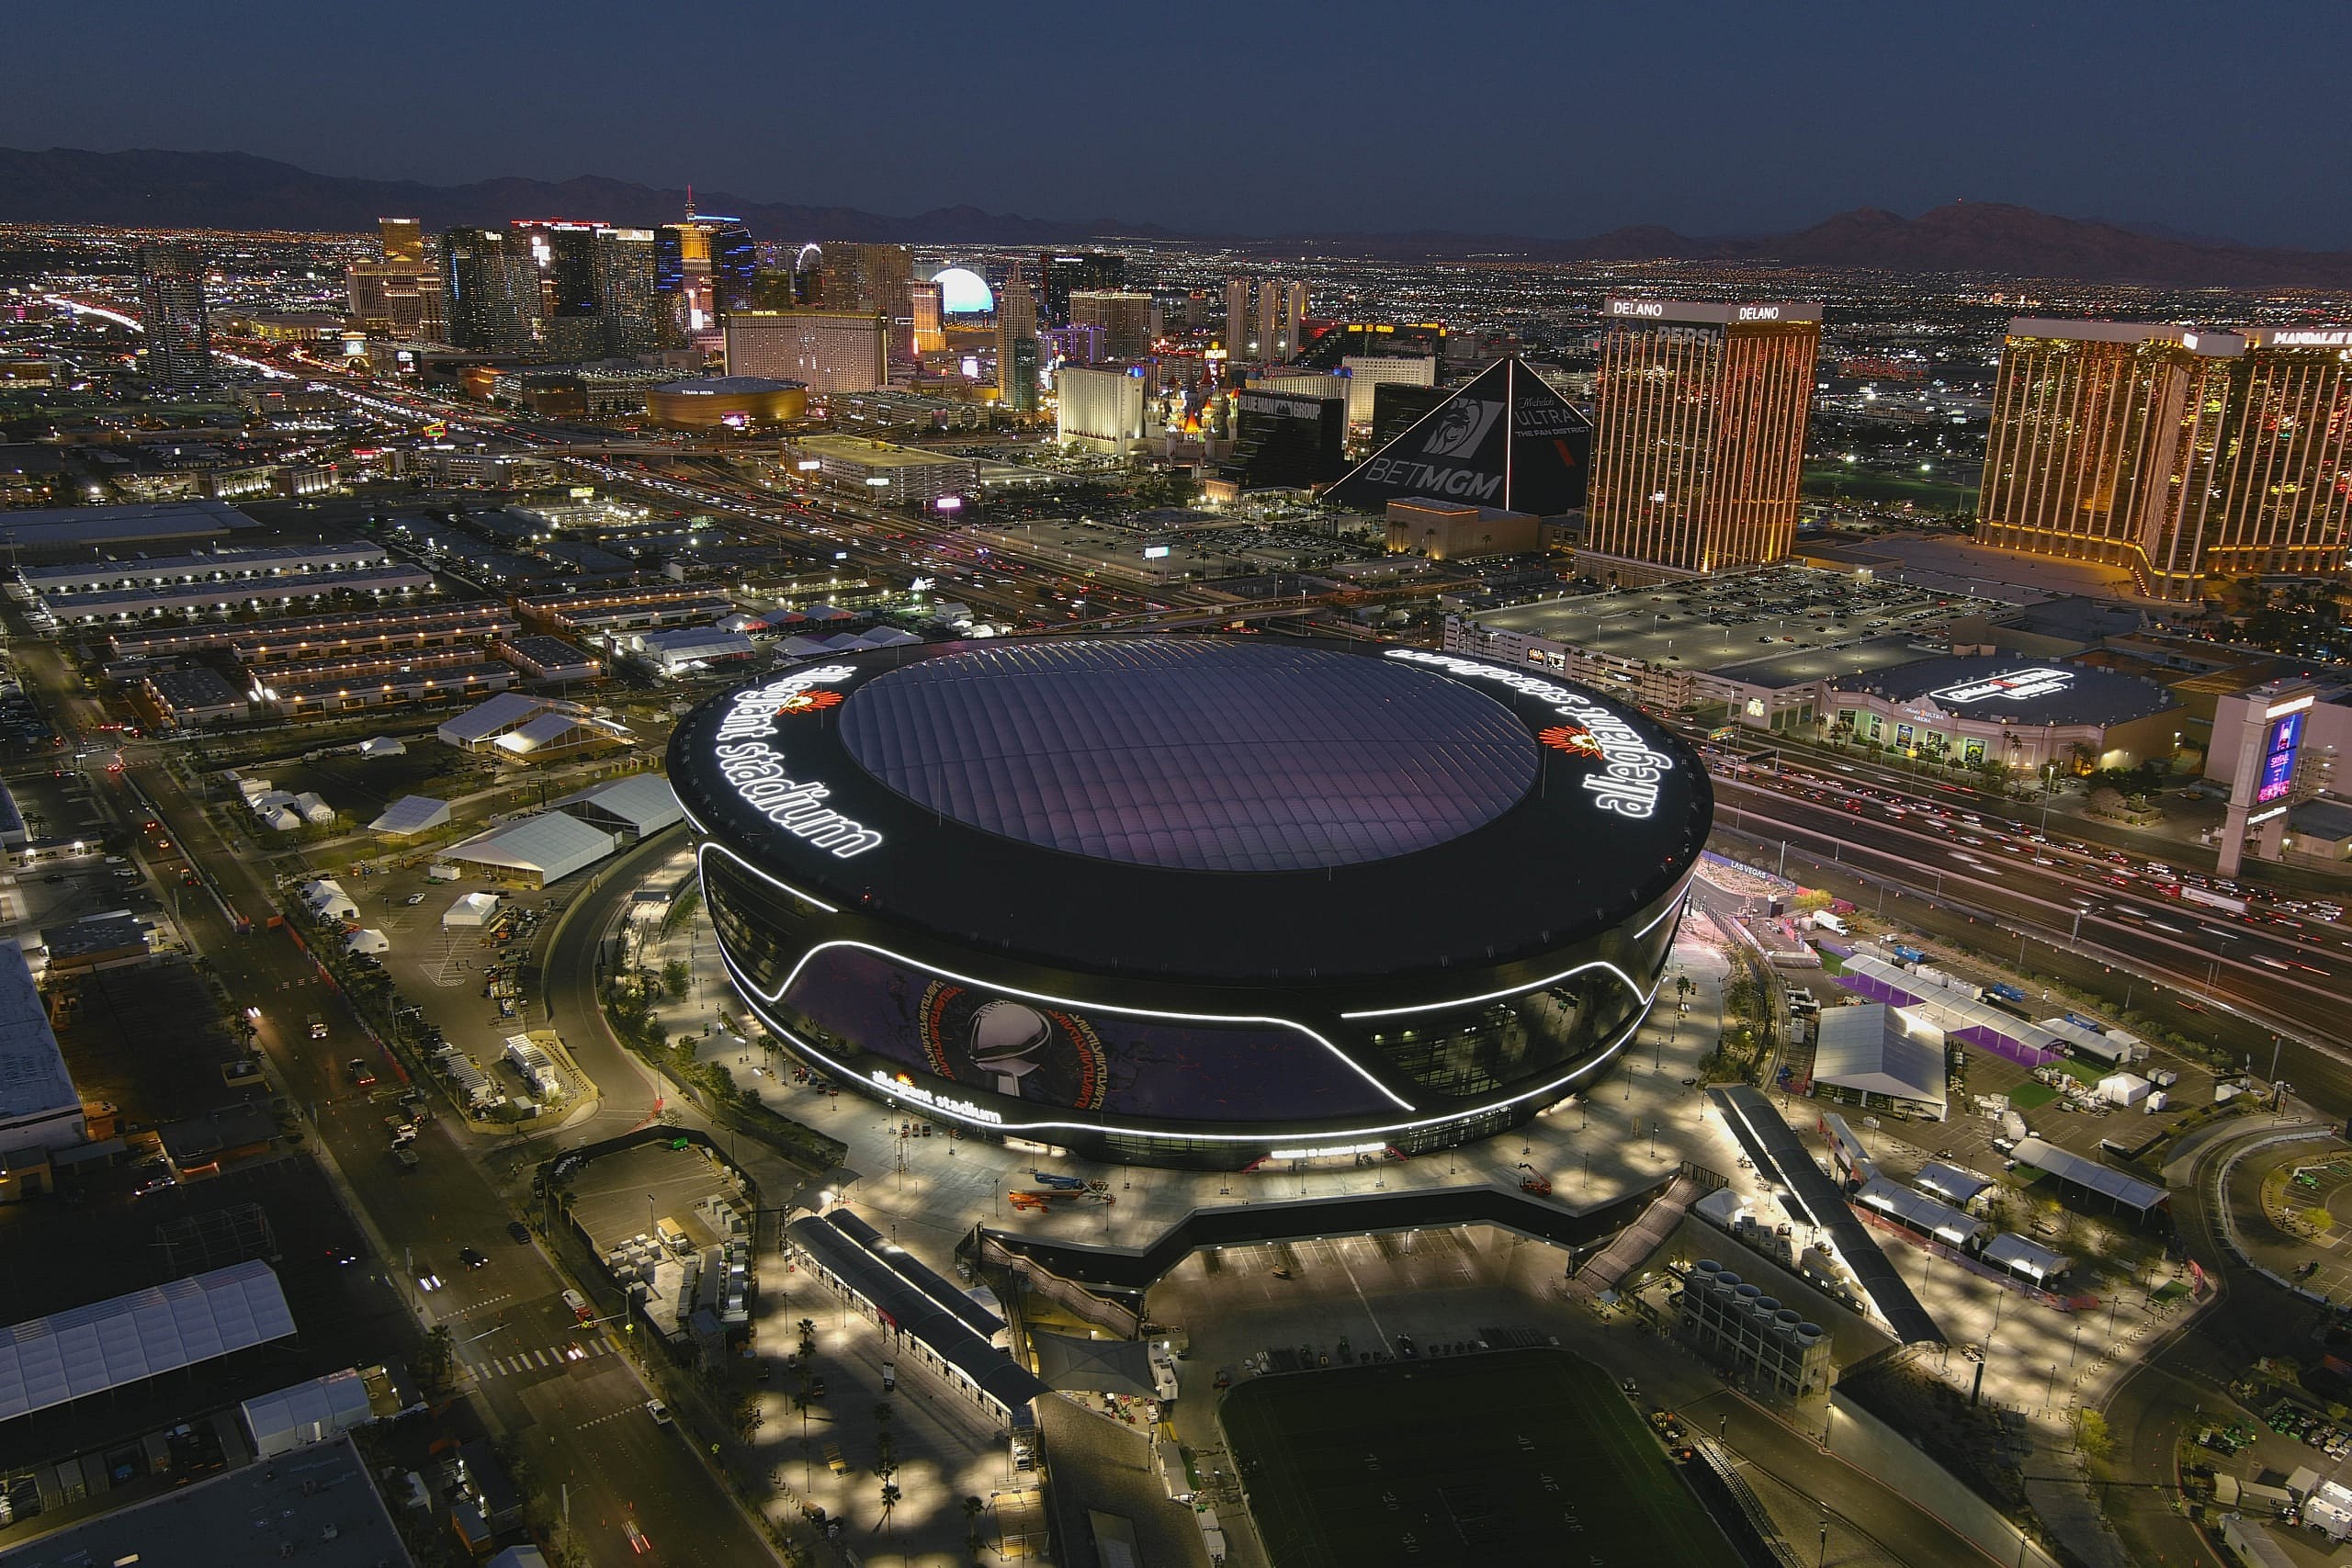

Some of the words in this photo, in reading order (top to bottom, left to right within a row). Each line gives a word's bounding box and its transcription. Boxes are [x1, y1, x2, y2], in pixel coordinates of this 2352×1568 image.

[1613, 302, 1663, 317] DELANO
[1739, 307, 1779, 321] DELANO
[1657, 325, 1718, 346] PEPSI
[1204, 349, 1227, 359] MGM
[1238, 394, 1258, 412] BLUE
[1258, 396, 1274, 414] MAN
[1293, 400, 1321, 420] GROUP
[1514, 409, 1576, 425] ULTRA
[1364, 457, 1503, 500] BETMGM
[715, 741, 883, 859] stadium
[1731, 861, 1744, 871] LAS
[1744, 865, 1767, 879] VEGAS
[872, 1070, 933, 1104] allegiant
[935, 1095, 1002, 1124] stadium
